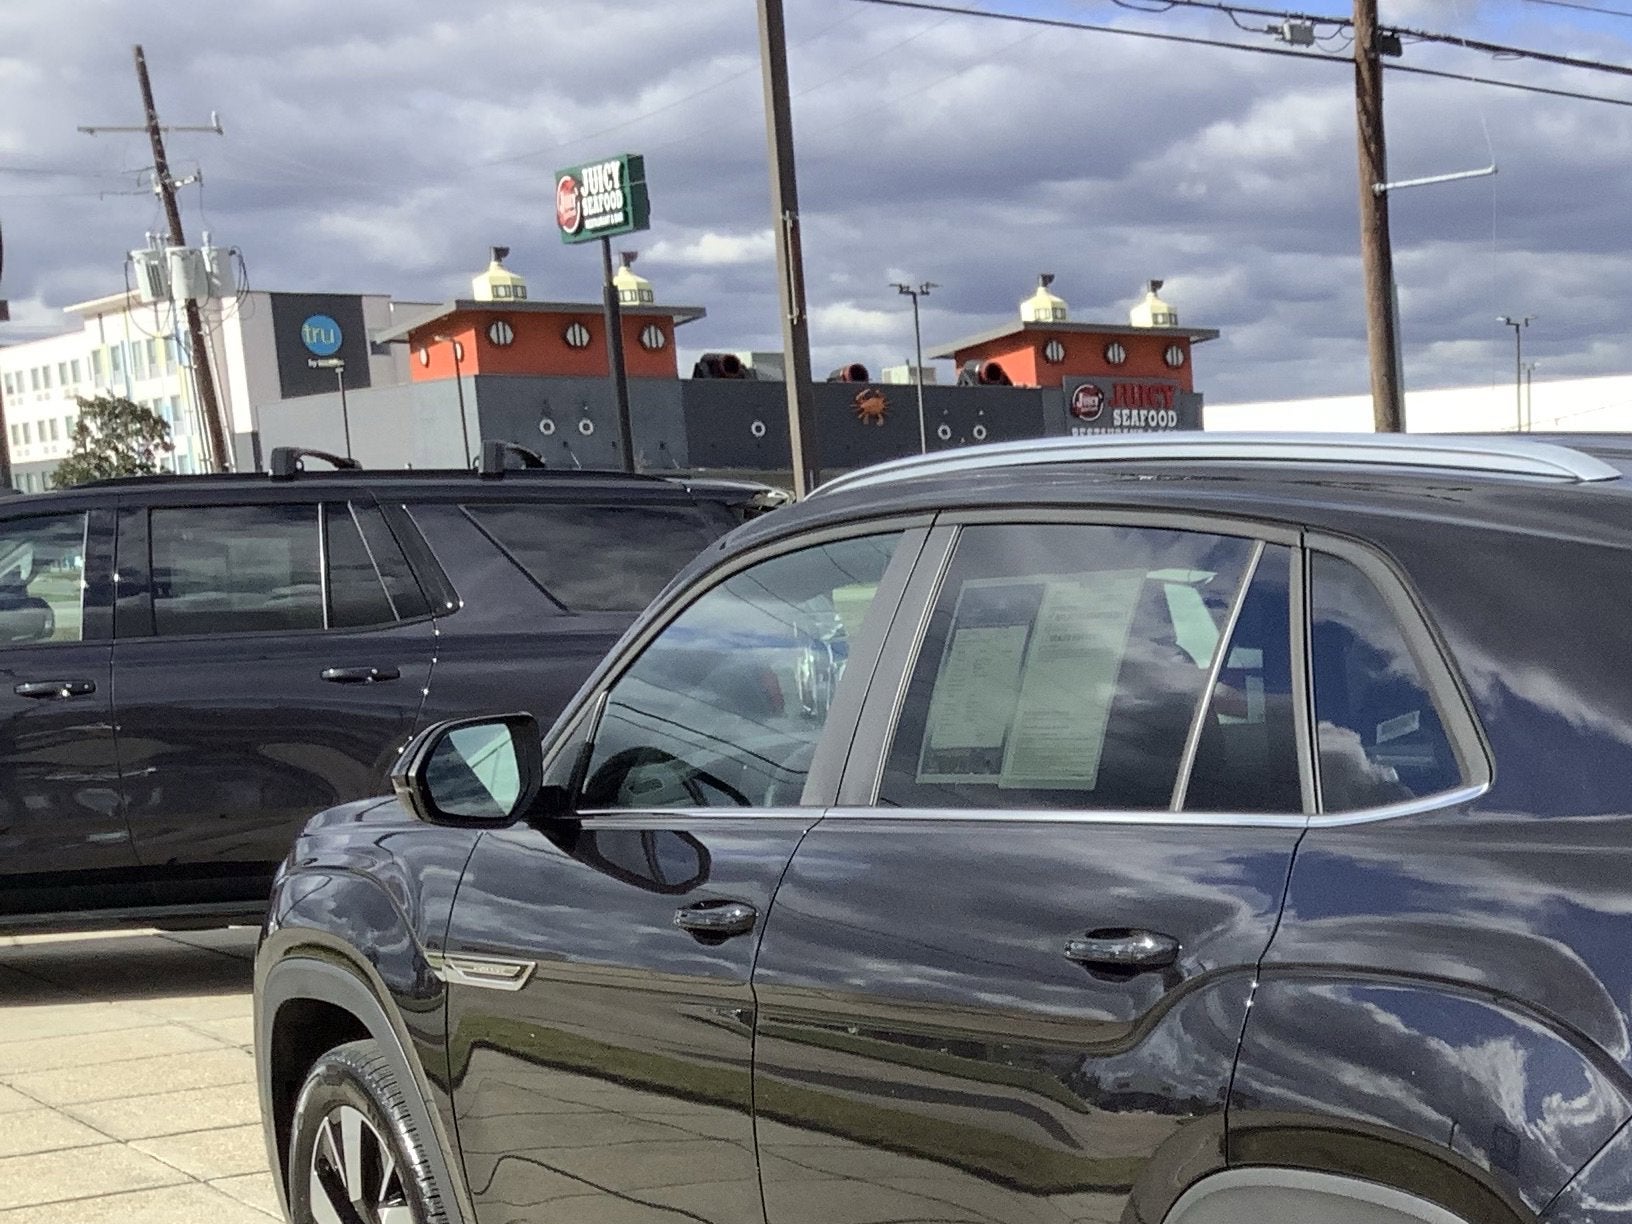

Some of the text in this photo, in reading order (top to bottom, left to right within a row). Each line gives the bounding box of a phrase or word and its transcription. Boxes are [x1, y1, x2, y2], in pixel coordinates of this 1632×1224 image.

[580, 160, 621, 197] JUICY
[581, 189, 624, 217] SEAFOOD
[302, 323, 335, 345] tru
[1108, 383, 1174, 409] JUICY
[1113, 409, 1178, 428] SEAFOOD
